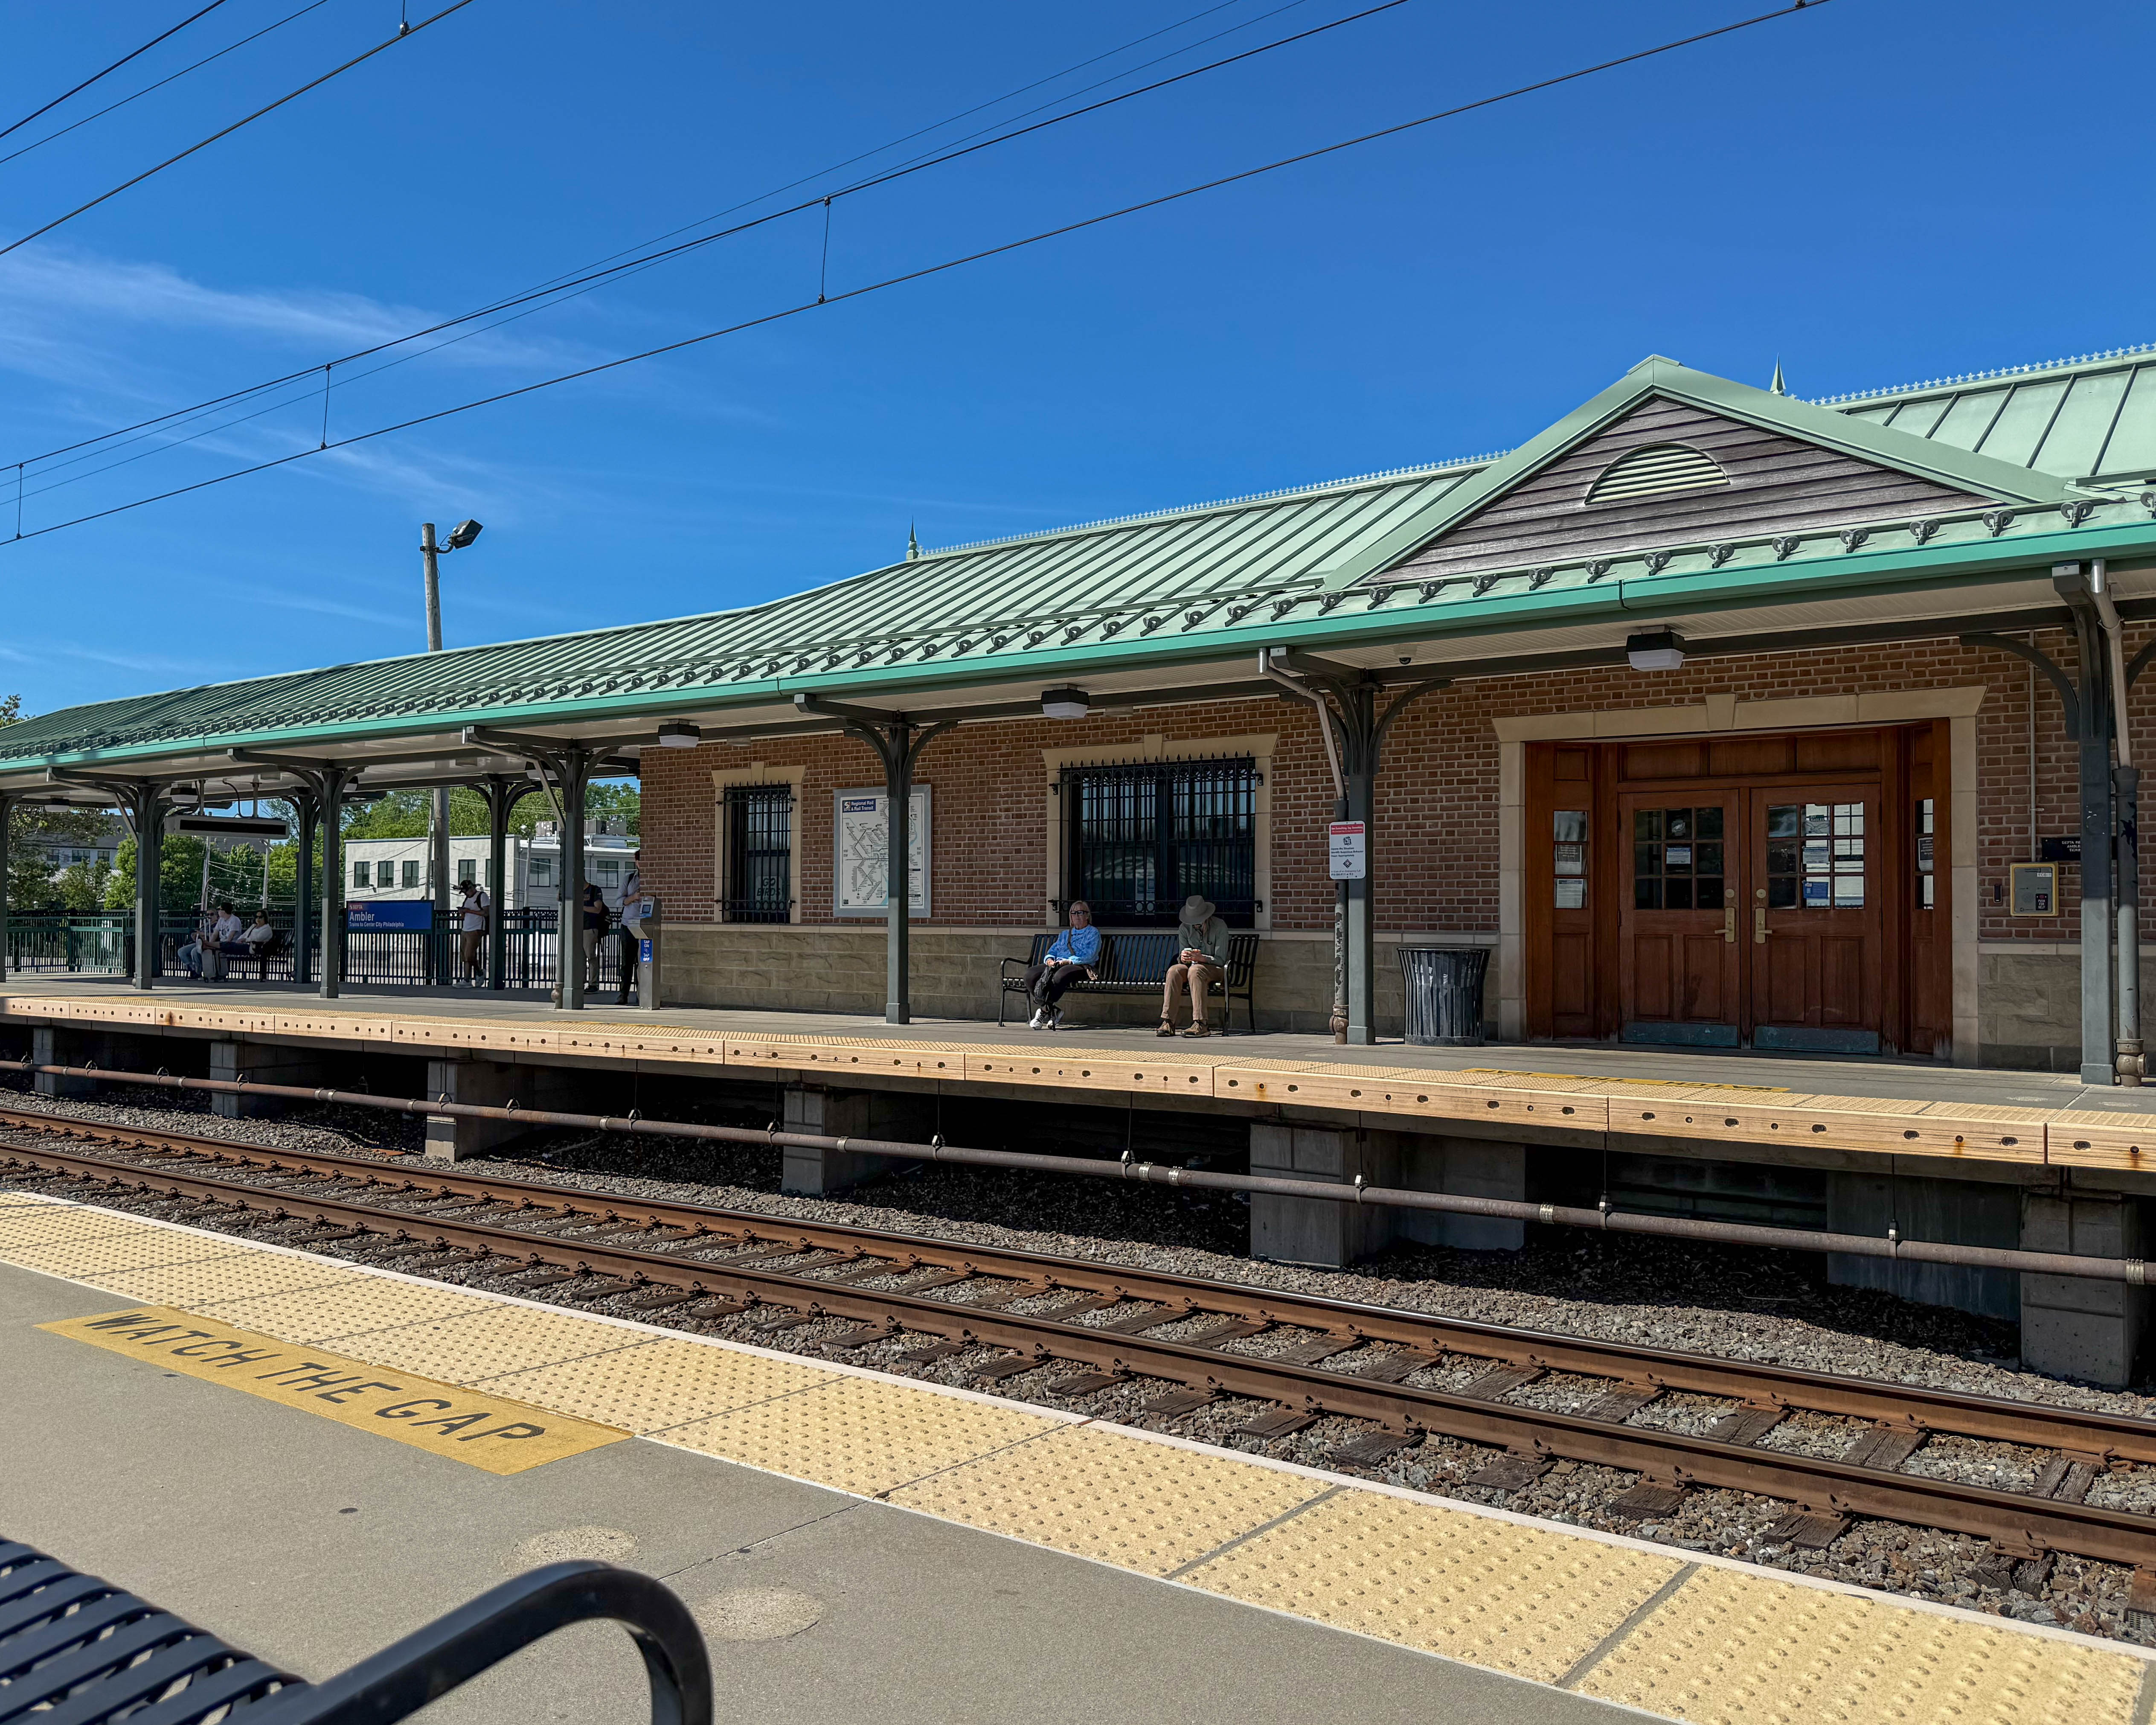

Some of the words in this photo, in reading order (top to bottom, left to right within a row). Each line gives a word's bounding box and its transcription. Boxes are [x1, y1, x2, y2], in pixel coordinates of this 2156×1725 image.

[764, 878, 776, 887] GO
[349, 911, 375, 921] Ambler
[1664, 1081, 1772, 1091] WATCH
[83, 1313, 283, 1368] WATCH
[254, 1362, 404, 1404] THE
[374, 1399, 546, 1442] GAP
